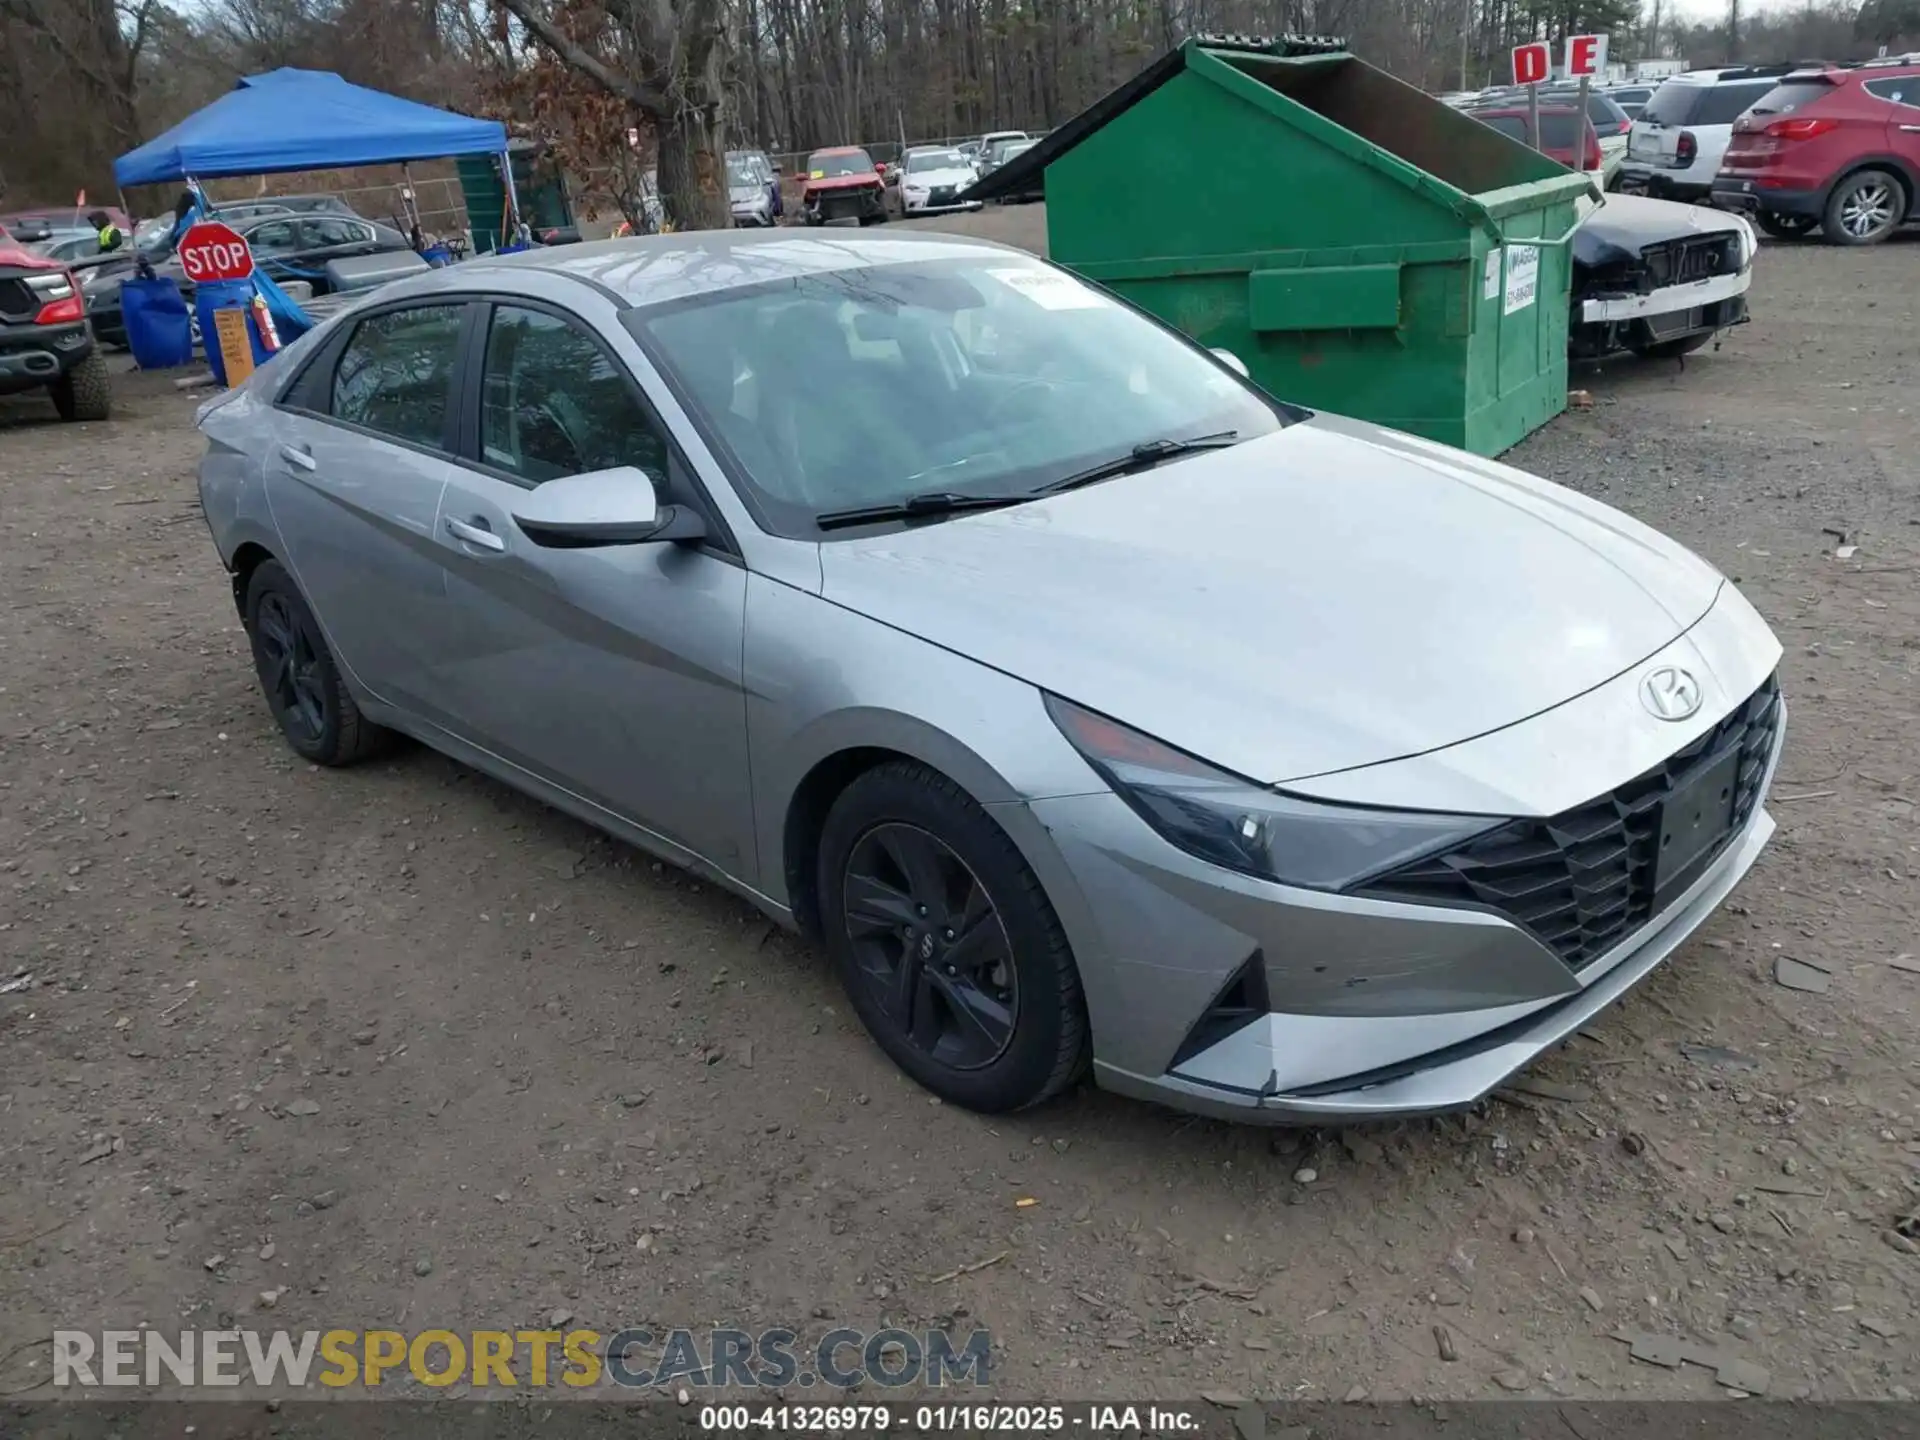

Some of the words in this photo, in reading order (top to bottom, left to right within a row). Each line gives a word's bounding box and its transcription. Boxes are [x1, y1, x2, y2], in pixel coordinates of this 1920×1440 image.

[1514, 45, 1547, 84] D
[1571, 38, 1597, 75] E
[185, 243, 245, 273] STOP
